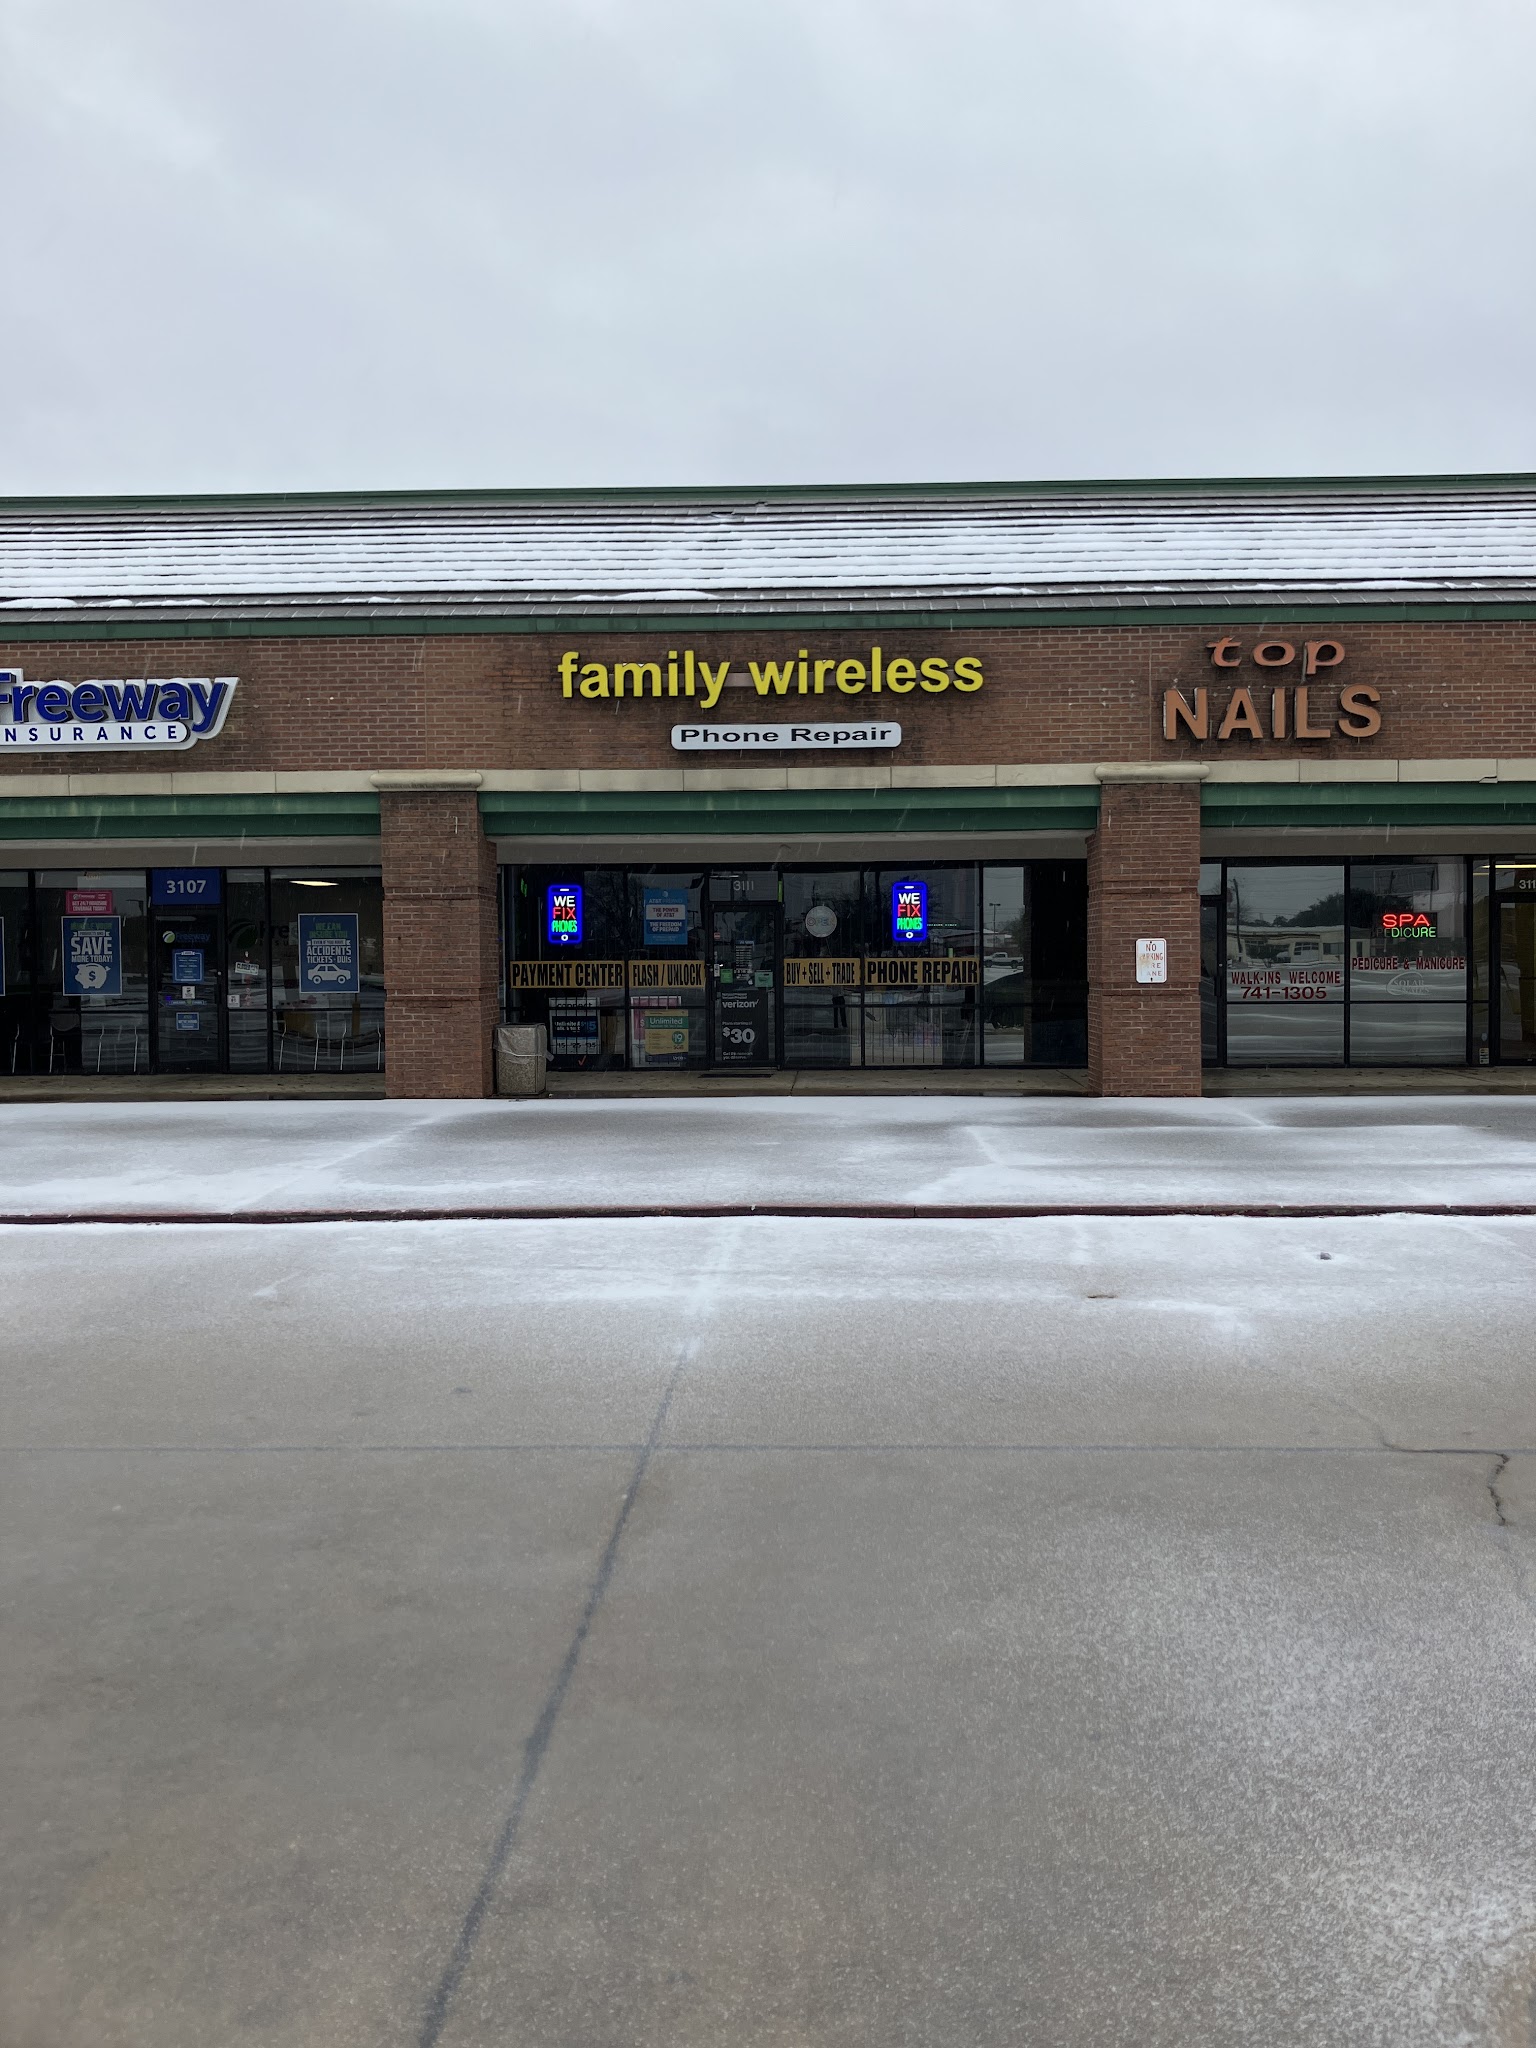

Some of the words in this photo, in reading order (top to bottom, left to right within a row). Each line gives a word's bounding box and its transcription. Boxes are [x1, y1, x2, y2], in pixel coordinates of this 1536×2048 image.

[1206, 637, 1345, 674] top
[558, 650, 730, 708] family
[748, 647, 984, 695] wireless
[1163, 684, 1382, 740] NAILS
[3, 725, 178, 742] NSURANCE
[681, 728, 779, 743] Phone
[790, 727, 892, 745] Repair
[166, 880, 207, 894] 3107
[733, 881, 755, 891] 3111
[554, 896, 576, 907] WE
[898, 893, 921, 904] WE
[552, 907, 577, 920] FIX
[897, 904, 921, 917] FIX
[551, 920, 578, 933] PHONES
[896, 917, 923, 930] PHONES
[1382, 913, 1431, 928] SPA
[71, 937, 113, 955] SAVE
[306, 946, 352, 956] ACCIDENTS
[306, 956, 333, 964] TICKETS
[1352, 957, 1398, 970] PEDICURE
[1416, 956, 1465, 970] MANICURE
[512, 963, 572, 987] PAYMENT
[575, 963, 623, 987] CENTER
[633, 964, 659, 986] FLASH
[667, 964, 702, 986] UNLOCK
[786, 963, 800, 984] BUY
[809, 963, 824, 984] SELL
[832, 962, 855, 984] TRADE
[867, 961, 918, 984] PHONE
[922, 961, 978, 984] REPAIR
[1231, 971, 1281, 985] WALK-INS
[1289, 971, 1341, 984] WELCOME
[1240, 986, 1327, 999] 741-1305
[722, 1000, 756, 1008] verizon
[650, 1017, 683, 1025] Unlimited
[722, 1026, 755, 1044] $30
